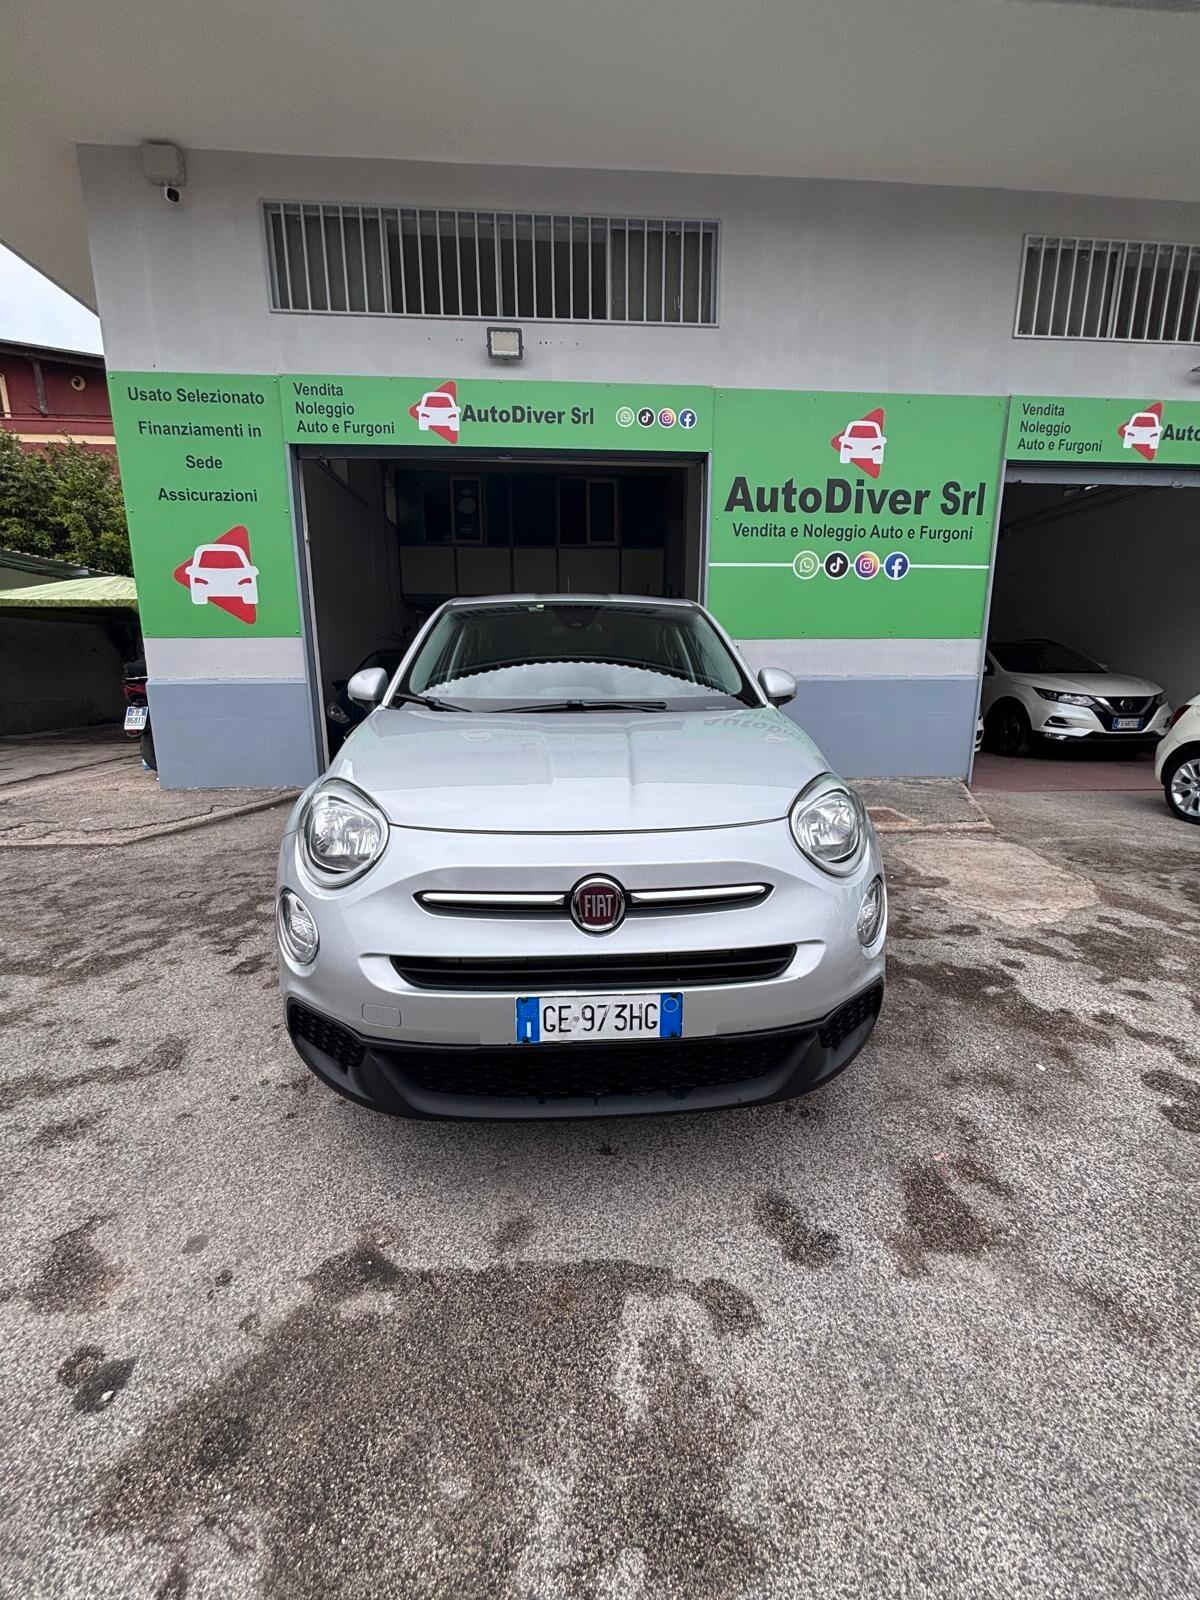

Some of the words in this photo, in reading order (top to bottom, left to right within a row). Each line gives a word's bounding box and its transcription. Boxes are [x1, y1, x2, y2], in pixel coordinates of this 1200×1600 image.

[127, 386, 172, 402] Usato
[176, 388, 265, 405] Selezionato
[293, 382, 344, 397] Vendita
[295, 401, 355, 416] Noleggio
[461, 404, 566, 424] AutoDiver
[571, 406, 594, 425] Srl
[1022, 402, 1065, 417] Vendita
[138, 421, 244, 437] Finanziamenti
[248, 423, 262, 438] in
[296, 420, 329, 433] Auto
[332, 423, 340, 434] e
[343, 420, 395, 436] Furgoni
[1019, 420, 1072, 436] Noleggio
[1017, 437, 1045, 451] Auto
[1048, 441, 1055, 451] e
[1057, 438, 1103, 455] Furgoni
[185, 454, 223, 469] Sede
[158, 487, 258, 502] Assicurazioni
[724, 476, 931, 515] AutoDiver
[940, 480, 987, 516] Srl
[732, 523, 786, 538] Vendita
[790, 527, 799, 538] e
[803, 524, 867, 542] Noleggio
[870, 525, 904, 539] Auto
[908, 528, 916, 539] e
[919, 526, 974, 544] Furgoni
[584, 894, 614, 917] FIAT
[543, 1005, 572, 1033] GE
[581, 1003, 658, 1032] 973HG
